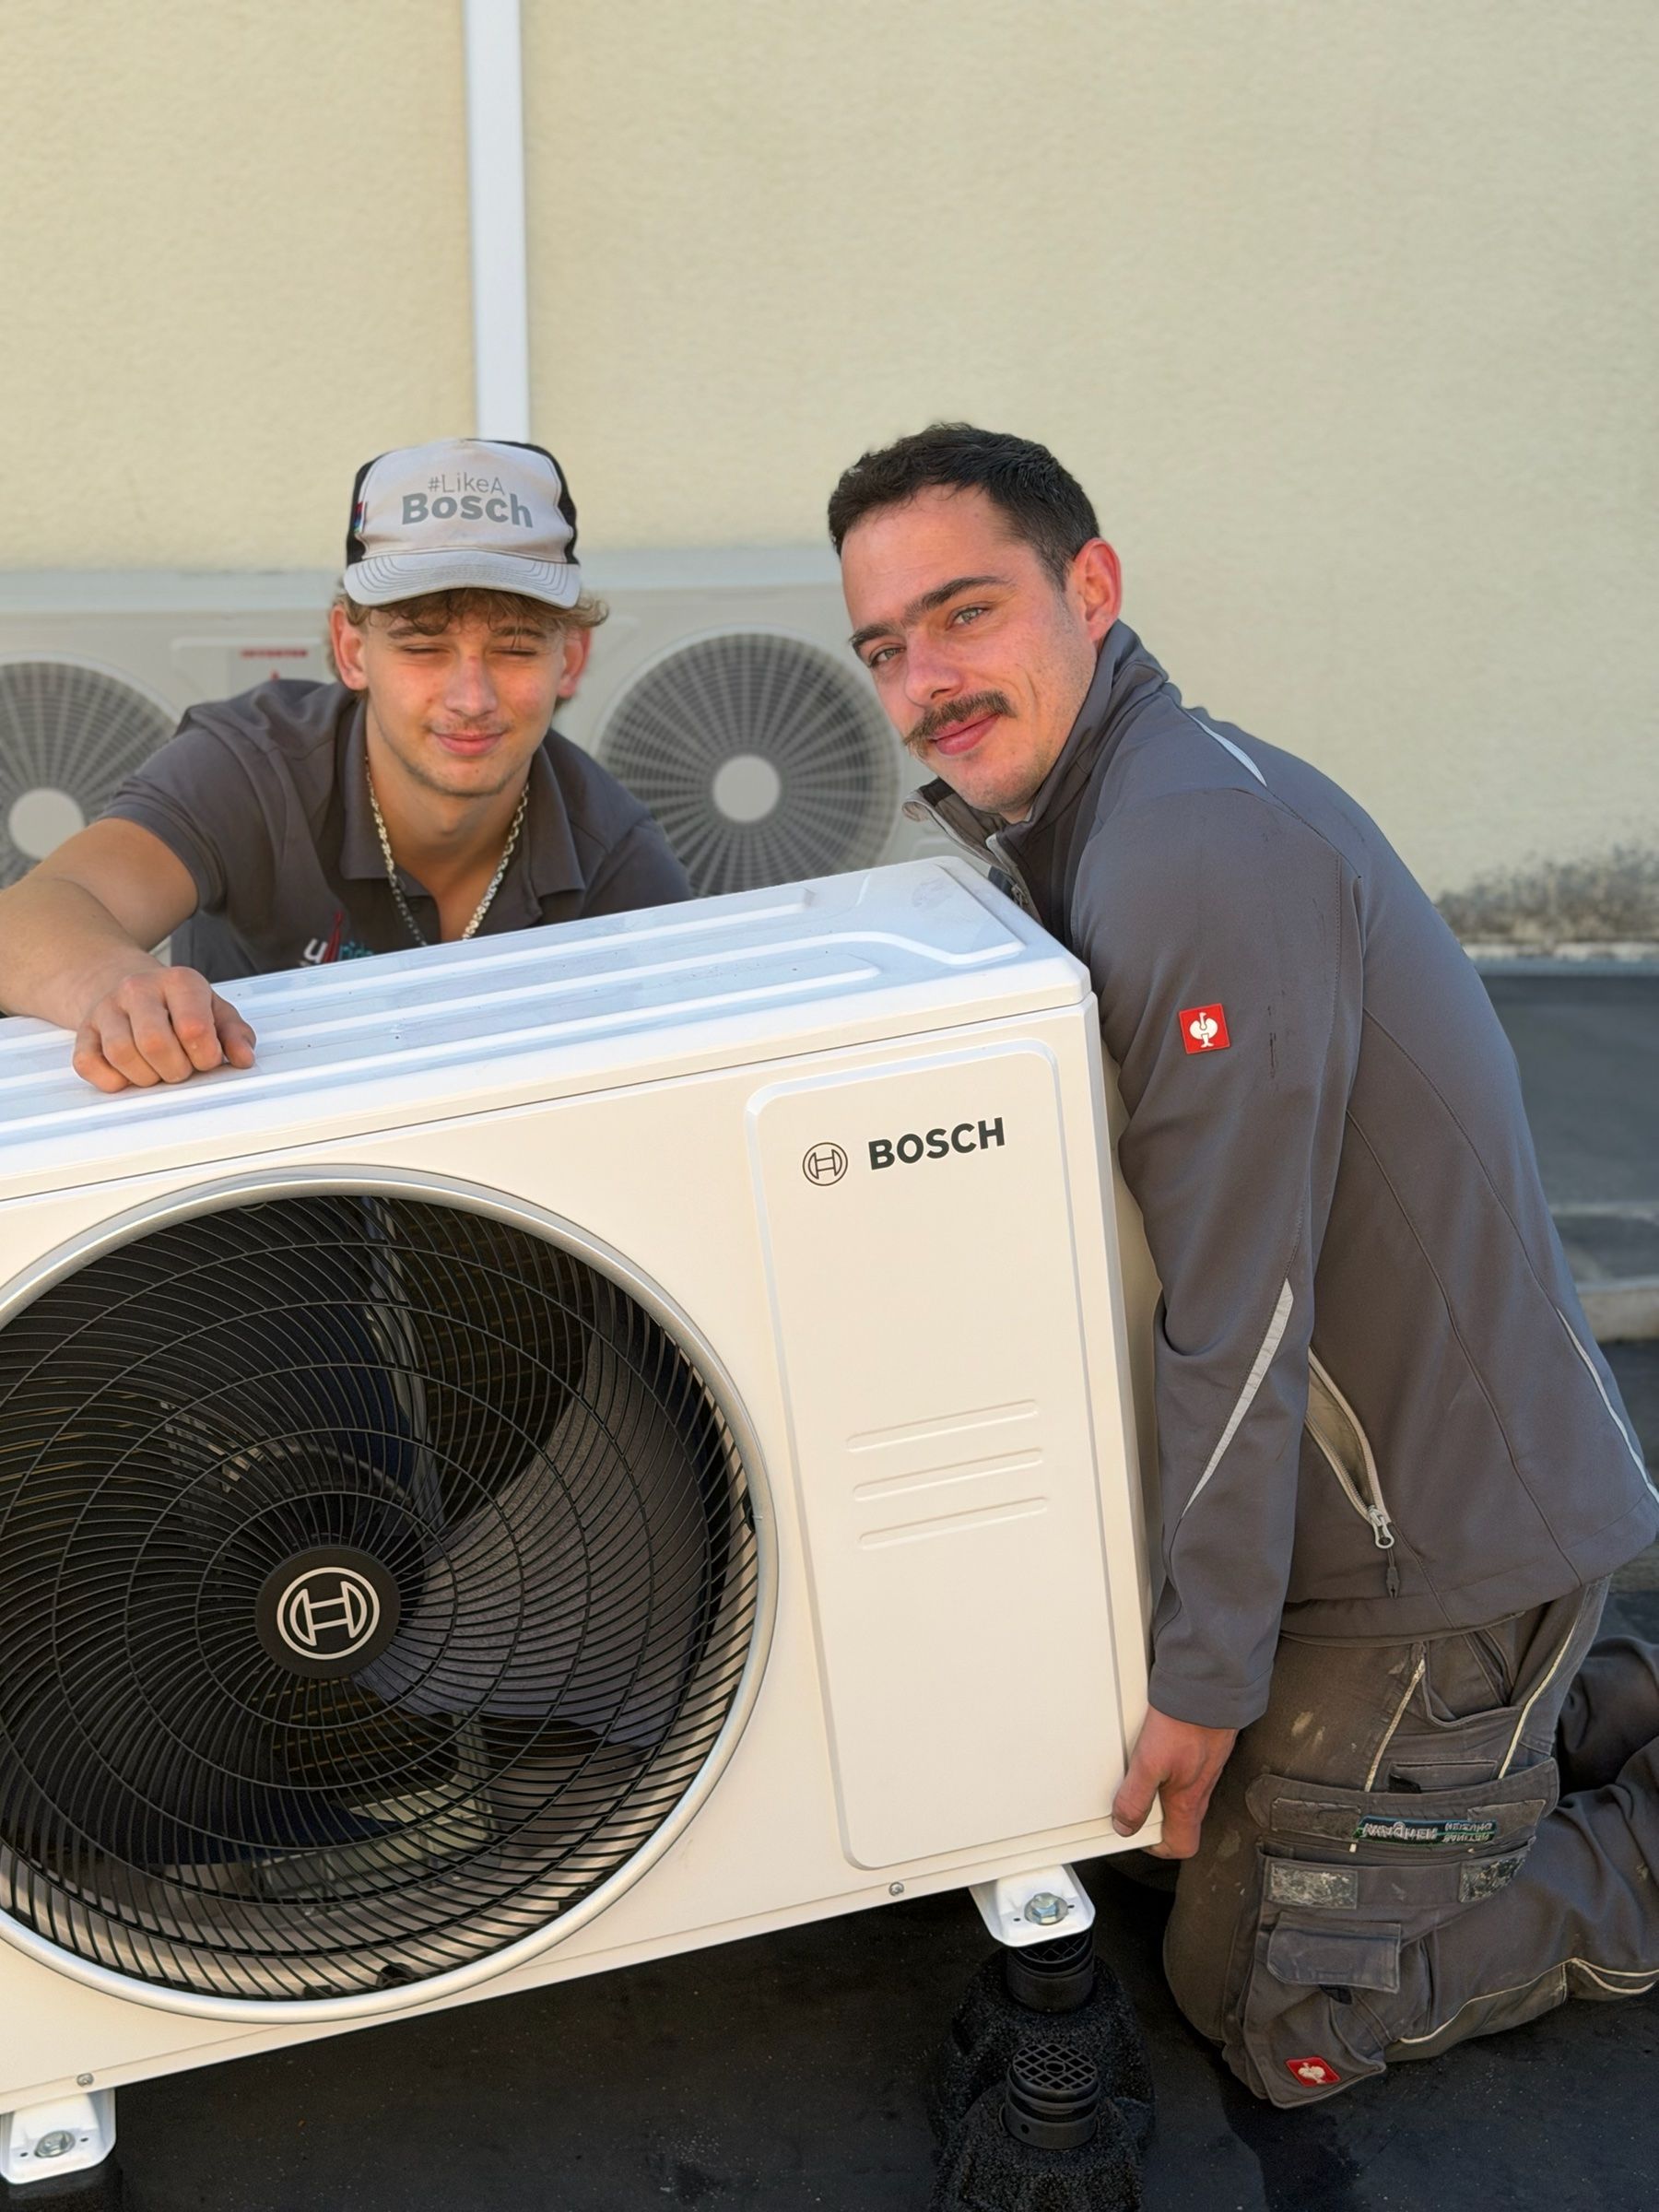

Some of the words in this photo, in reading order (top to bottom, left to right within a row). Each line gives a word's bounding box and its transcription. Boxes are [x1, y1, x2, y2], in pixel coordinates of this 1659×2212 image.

[427, 472, 505, 496] #LikeA
[401, 492, 534, 528] Bosch
[868, 1117, 1006, 1171] BOSCH
